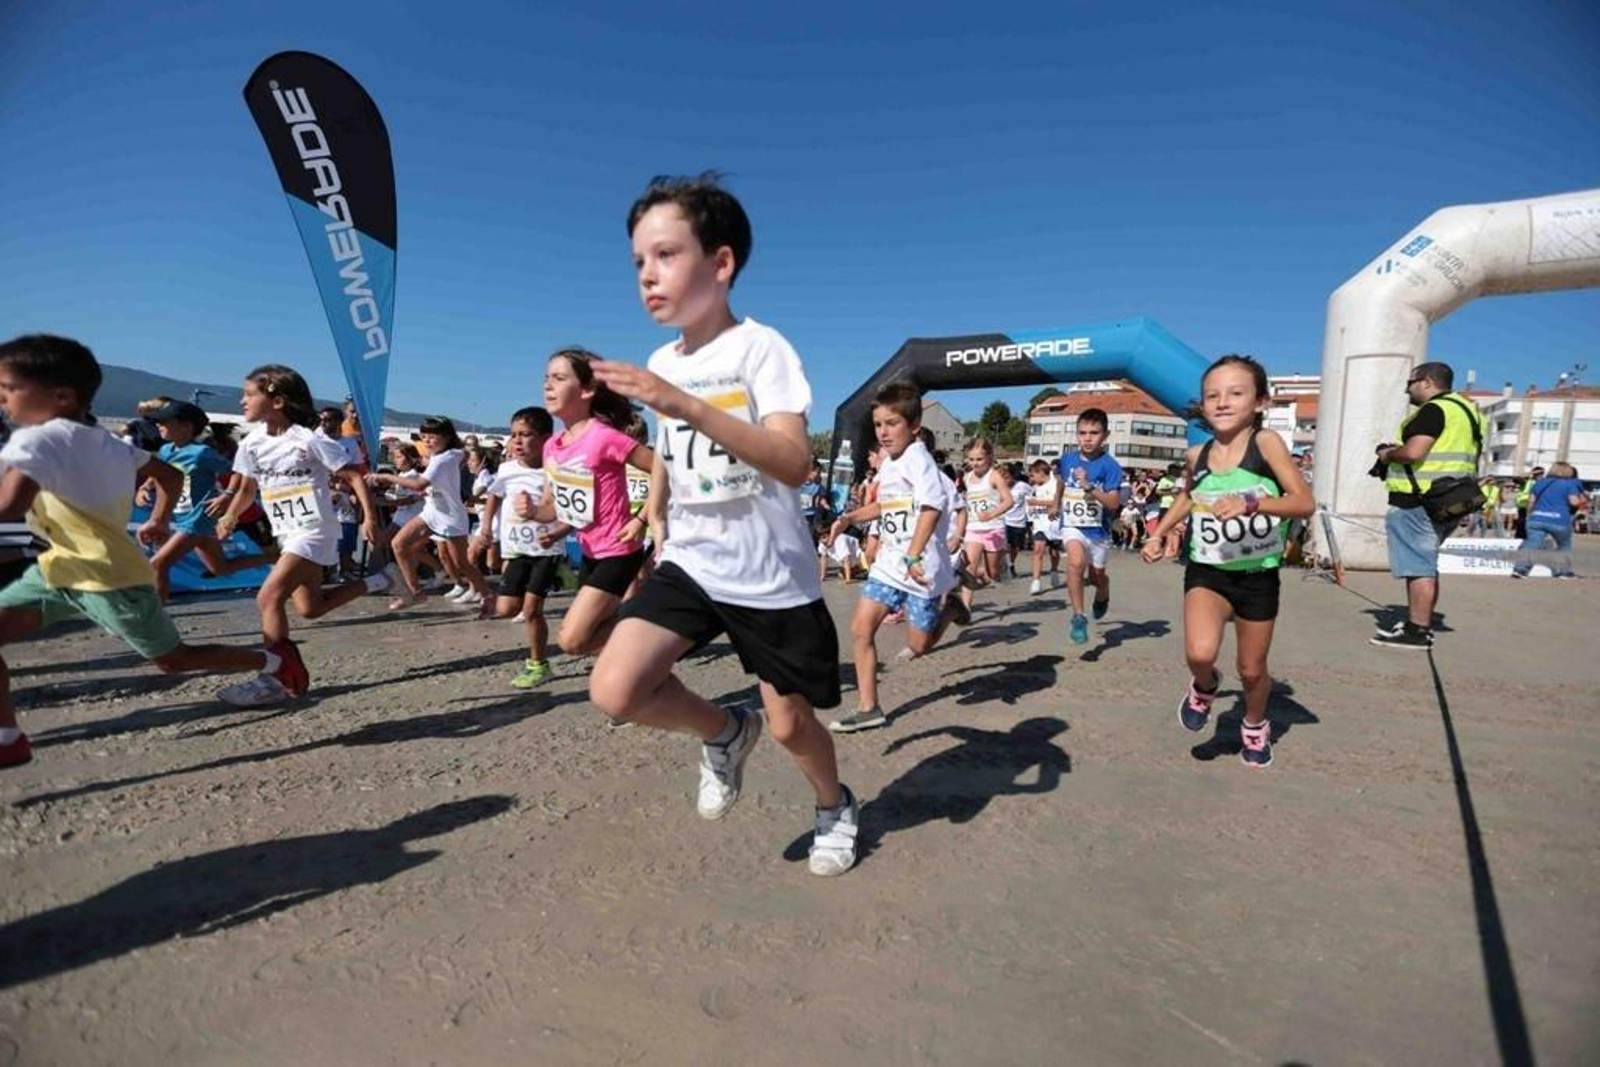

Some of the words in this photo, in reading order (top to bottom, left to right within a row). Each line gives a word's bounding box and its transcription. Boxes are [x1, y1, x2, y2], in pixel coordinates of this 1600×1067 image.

[945, 337, 1091, 368] POWERADE
[272, 496, 315, 521] 471
[549, 482, 588, 514] 56
[877, 510, 909, 534] 67
[1201, 511, 1272, 544] 500
